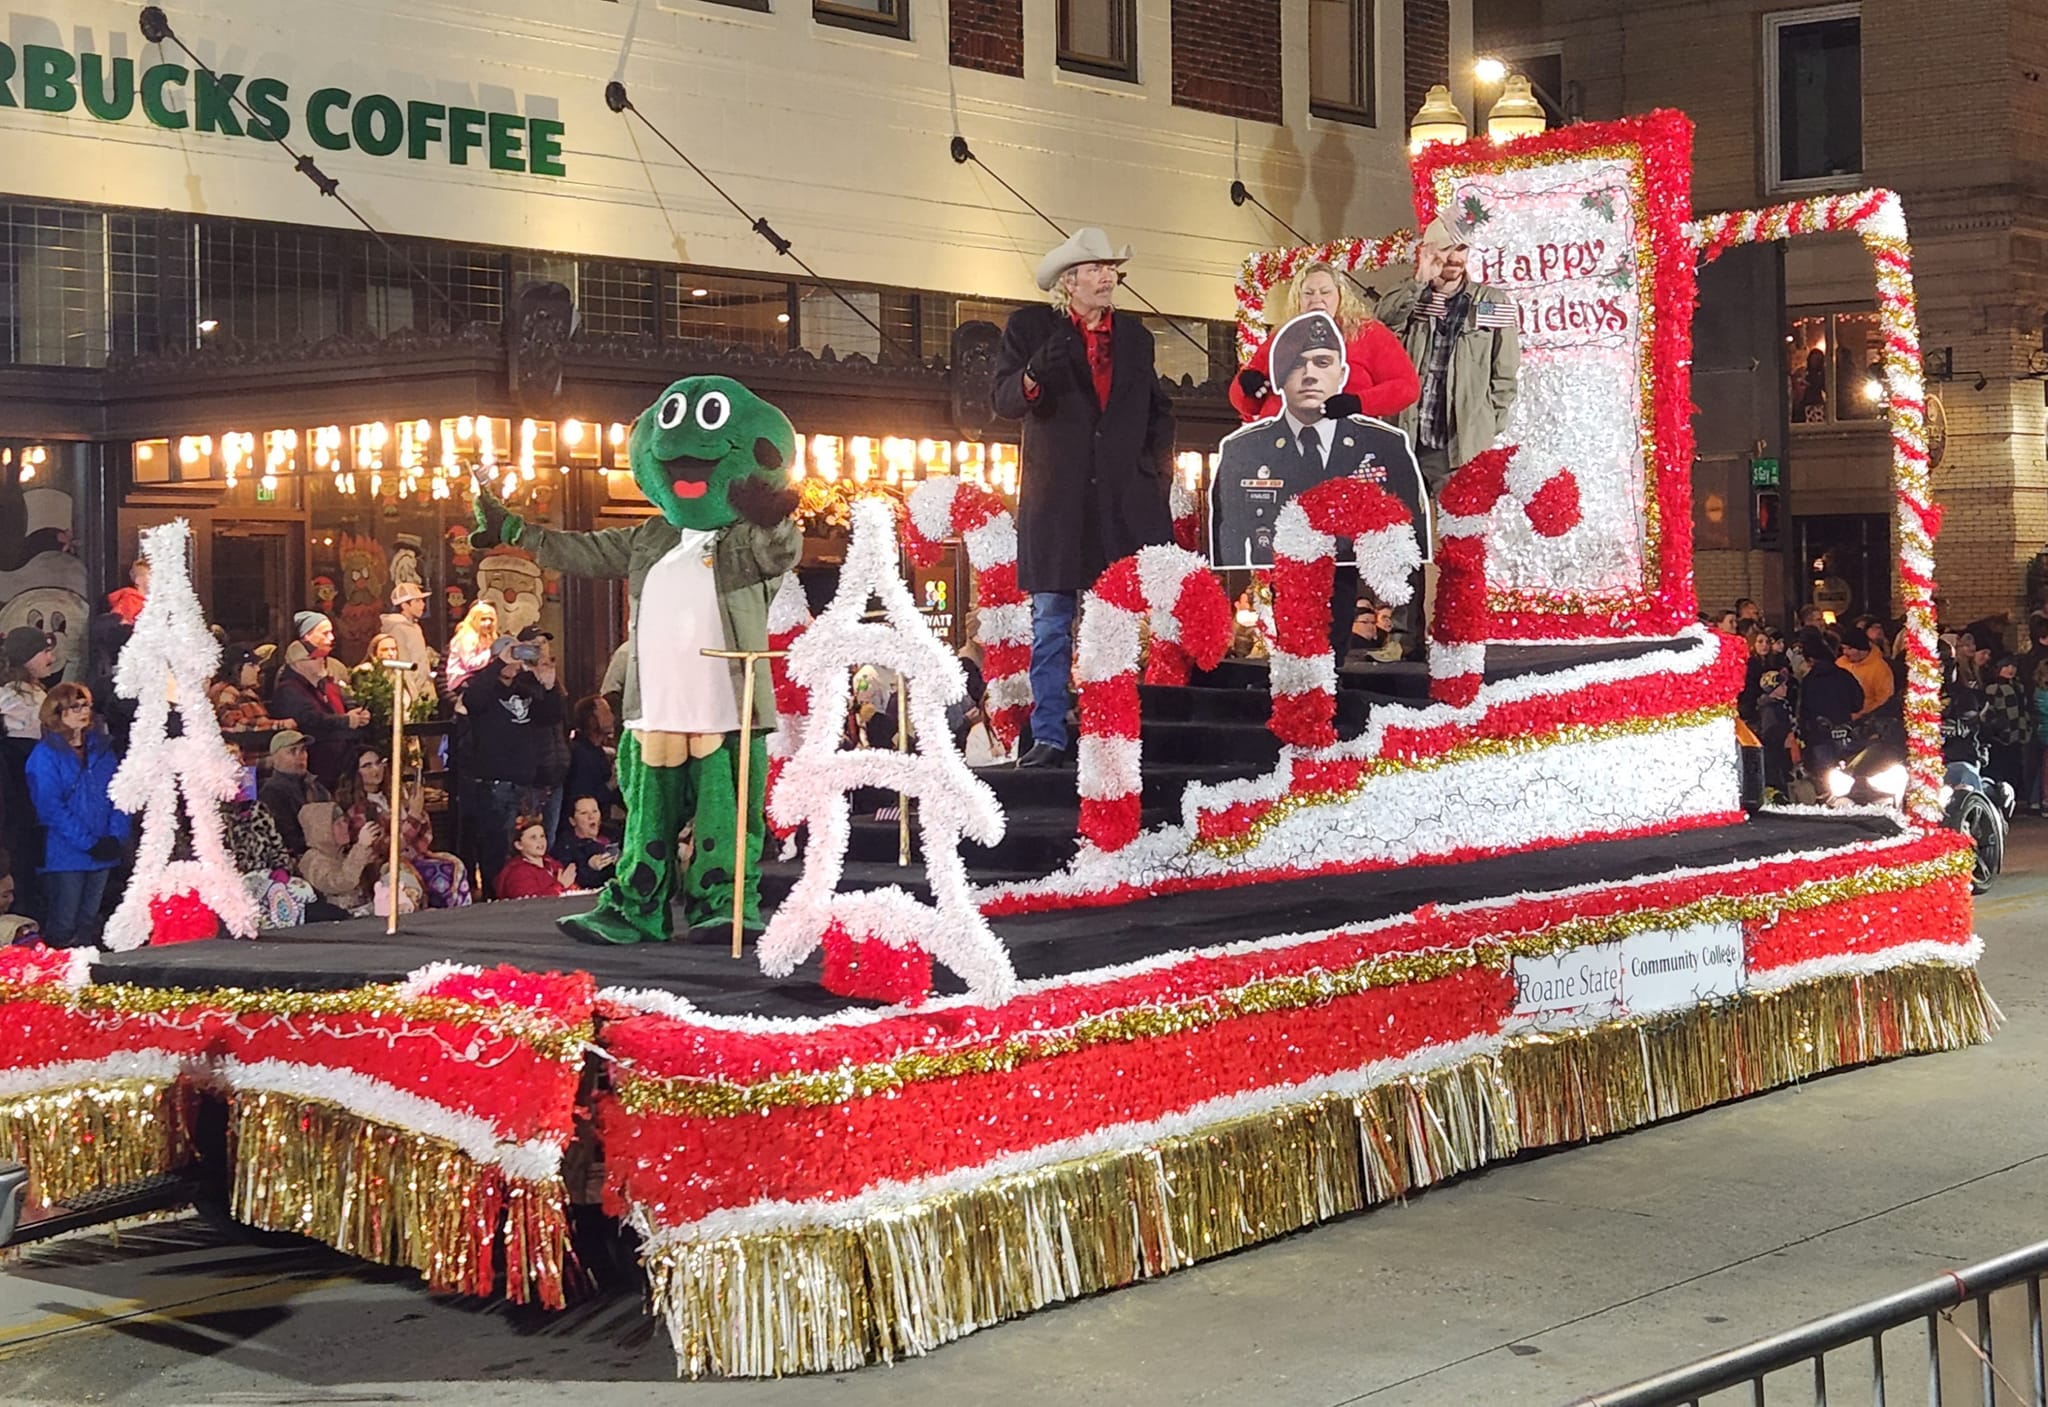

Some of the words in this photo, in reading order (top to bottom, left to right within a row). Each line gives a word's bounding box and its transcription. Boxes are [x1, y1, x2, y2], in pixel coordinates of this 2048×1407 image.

[306, 88, 567, 177] COFFEE
[1480, 238, 1605, 285] Happy
[1517, 295, 1629, 335] lidays
[924, 614, 952, 627] YATT
[1518, 973, 1575, 1004] Roane
[1579, 964, 1618, 996] State
[1631, 952, 1698, 977] Community
[1702, 944, 1738, 968] College
